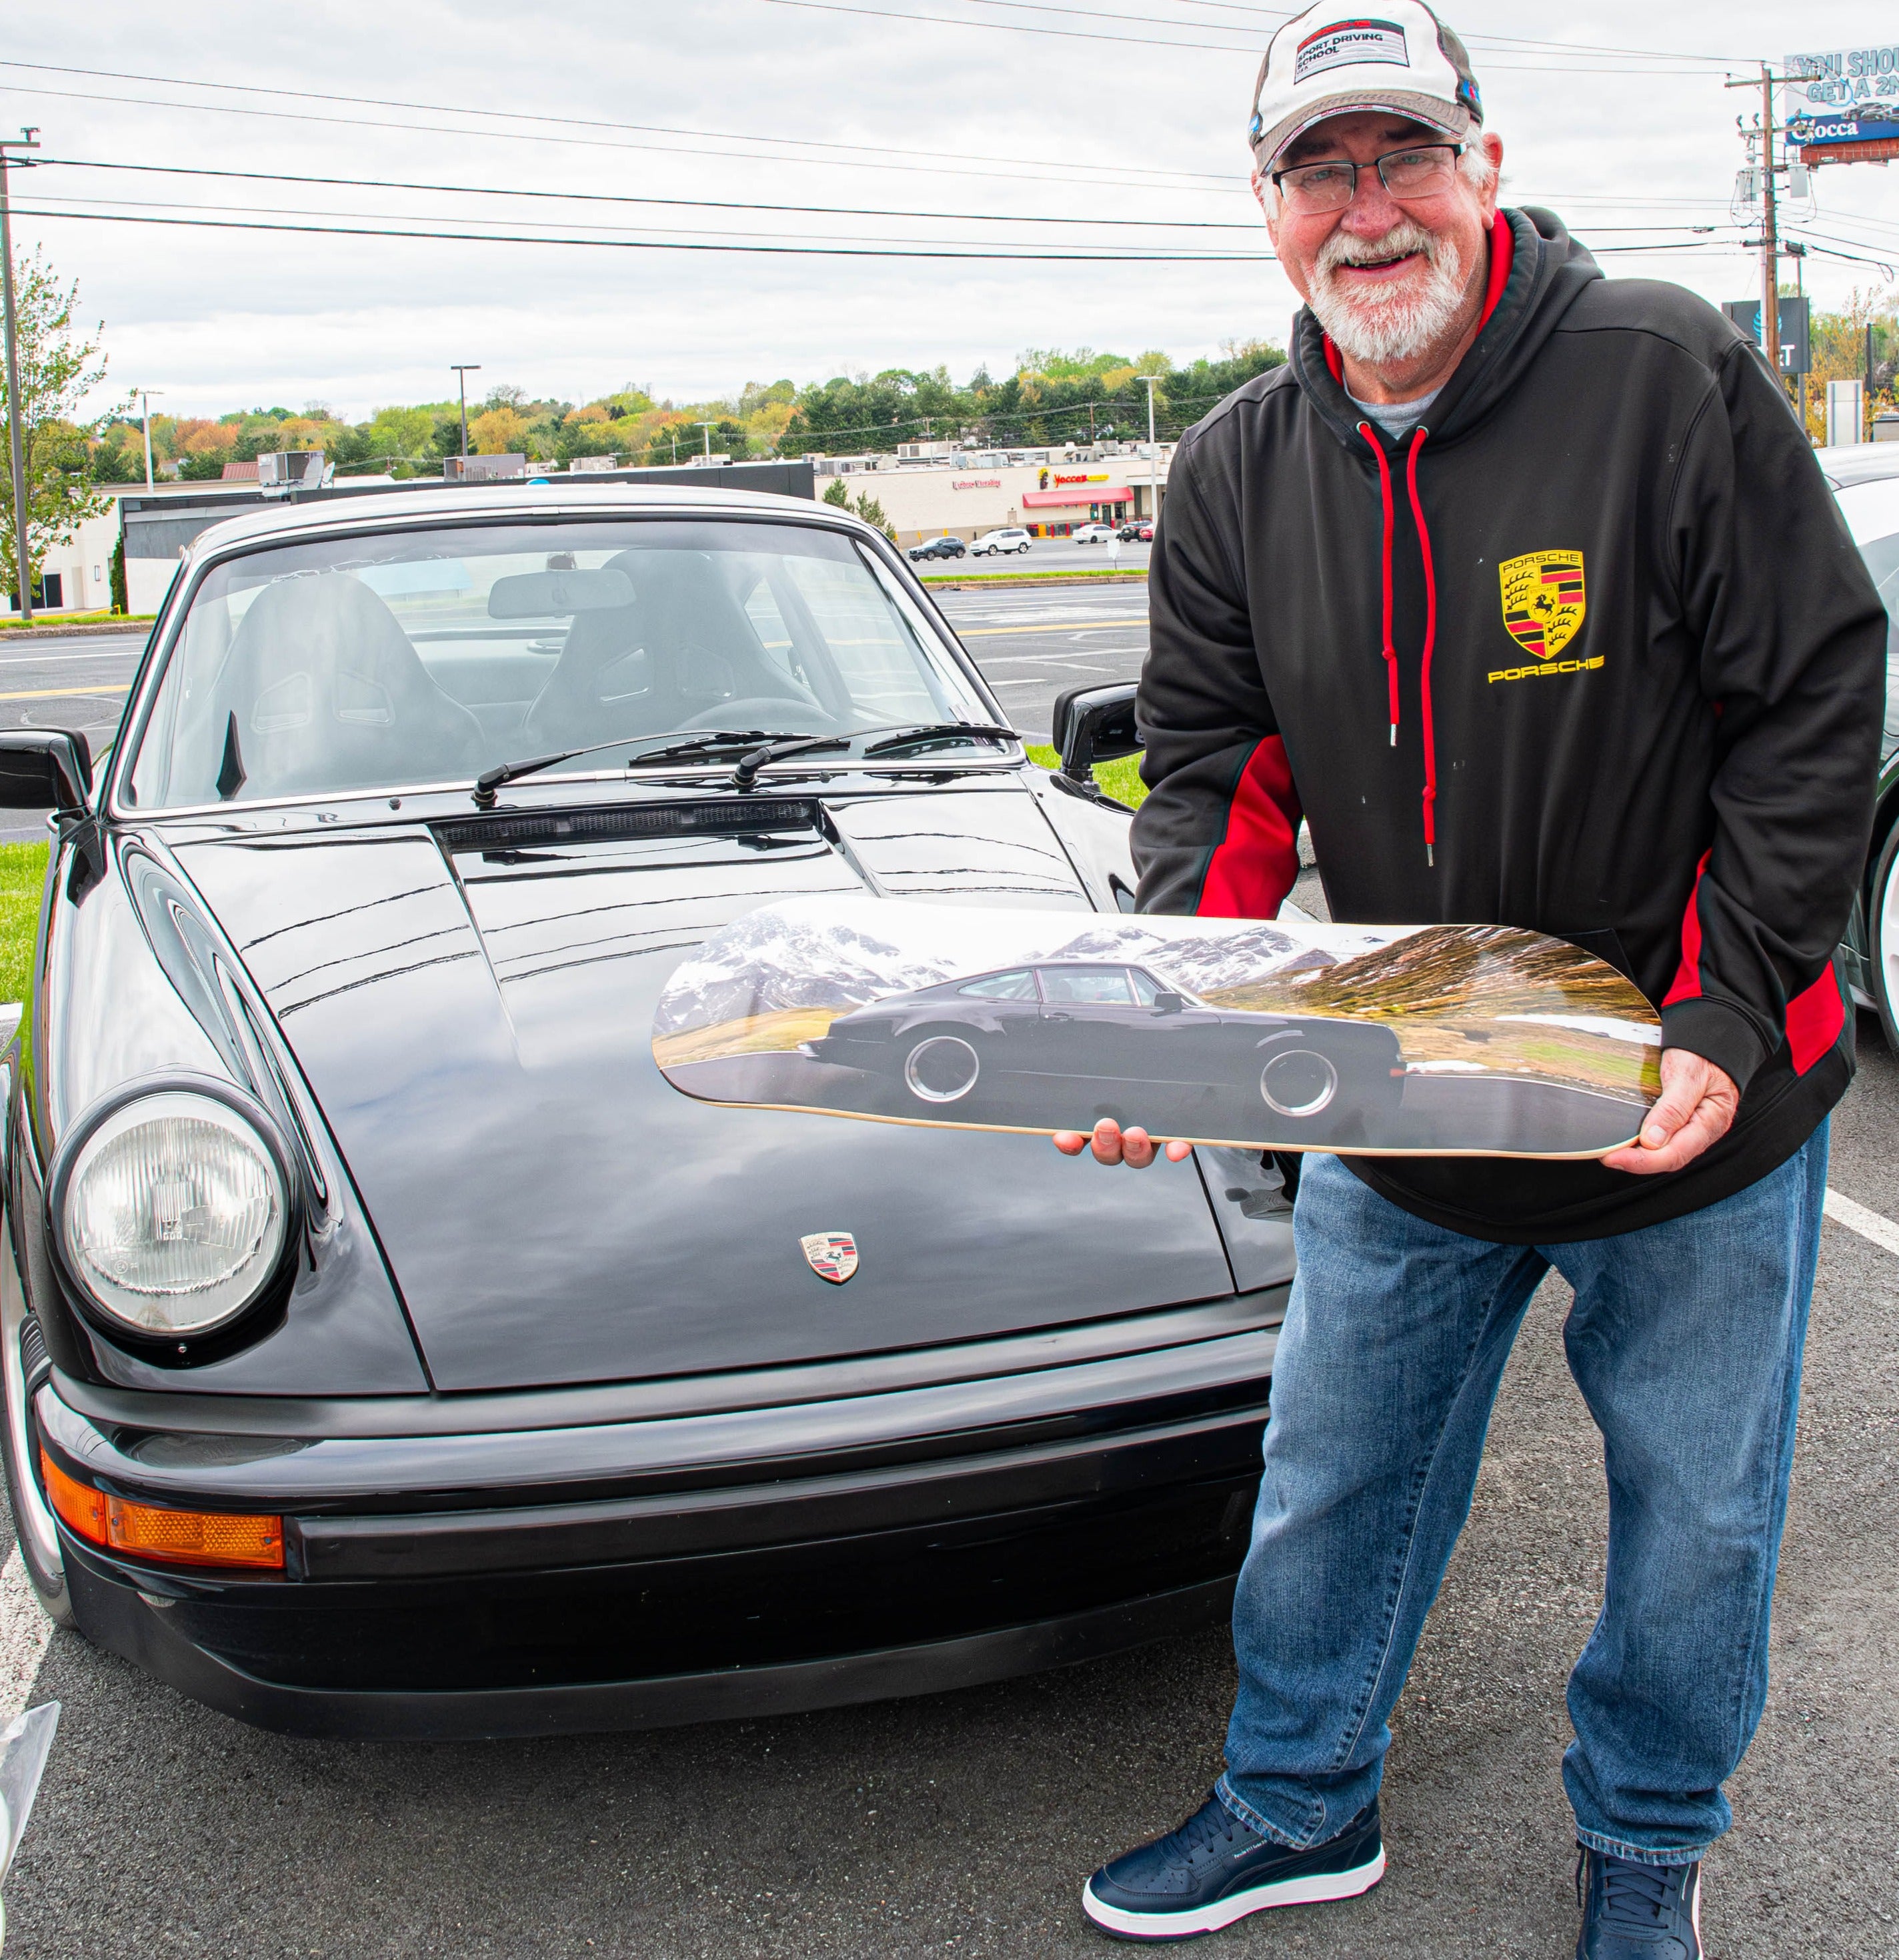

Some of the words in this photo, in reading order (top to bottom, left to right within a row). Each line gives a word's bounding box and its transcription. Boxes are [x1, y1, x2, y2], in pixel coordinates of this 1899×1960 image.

[1298, 40, 1330, 63] SPORT
[1332, 33, 1384, 45] DRIVING
[1298, 46, 1340, 70] SCHOOL
[1797, 53, 1842, 80] YOU
[1807, 78, 1847, 103] GET
[1854, 78, 1870, 98] A
[1503, 553, 1580, 574] PORSCHE
[1488, 655, 1605, 684] PORSCHE
